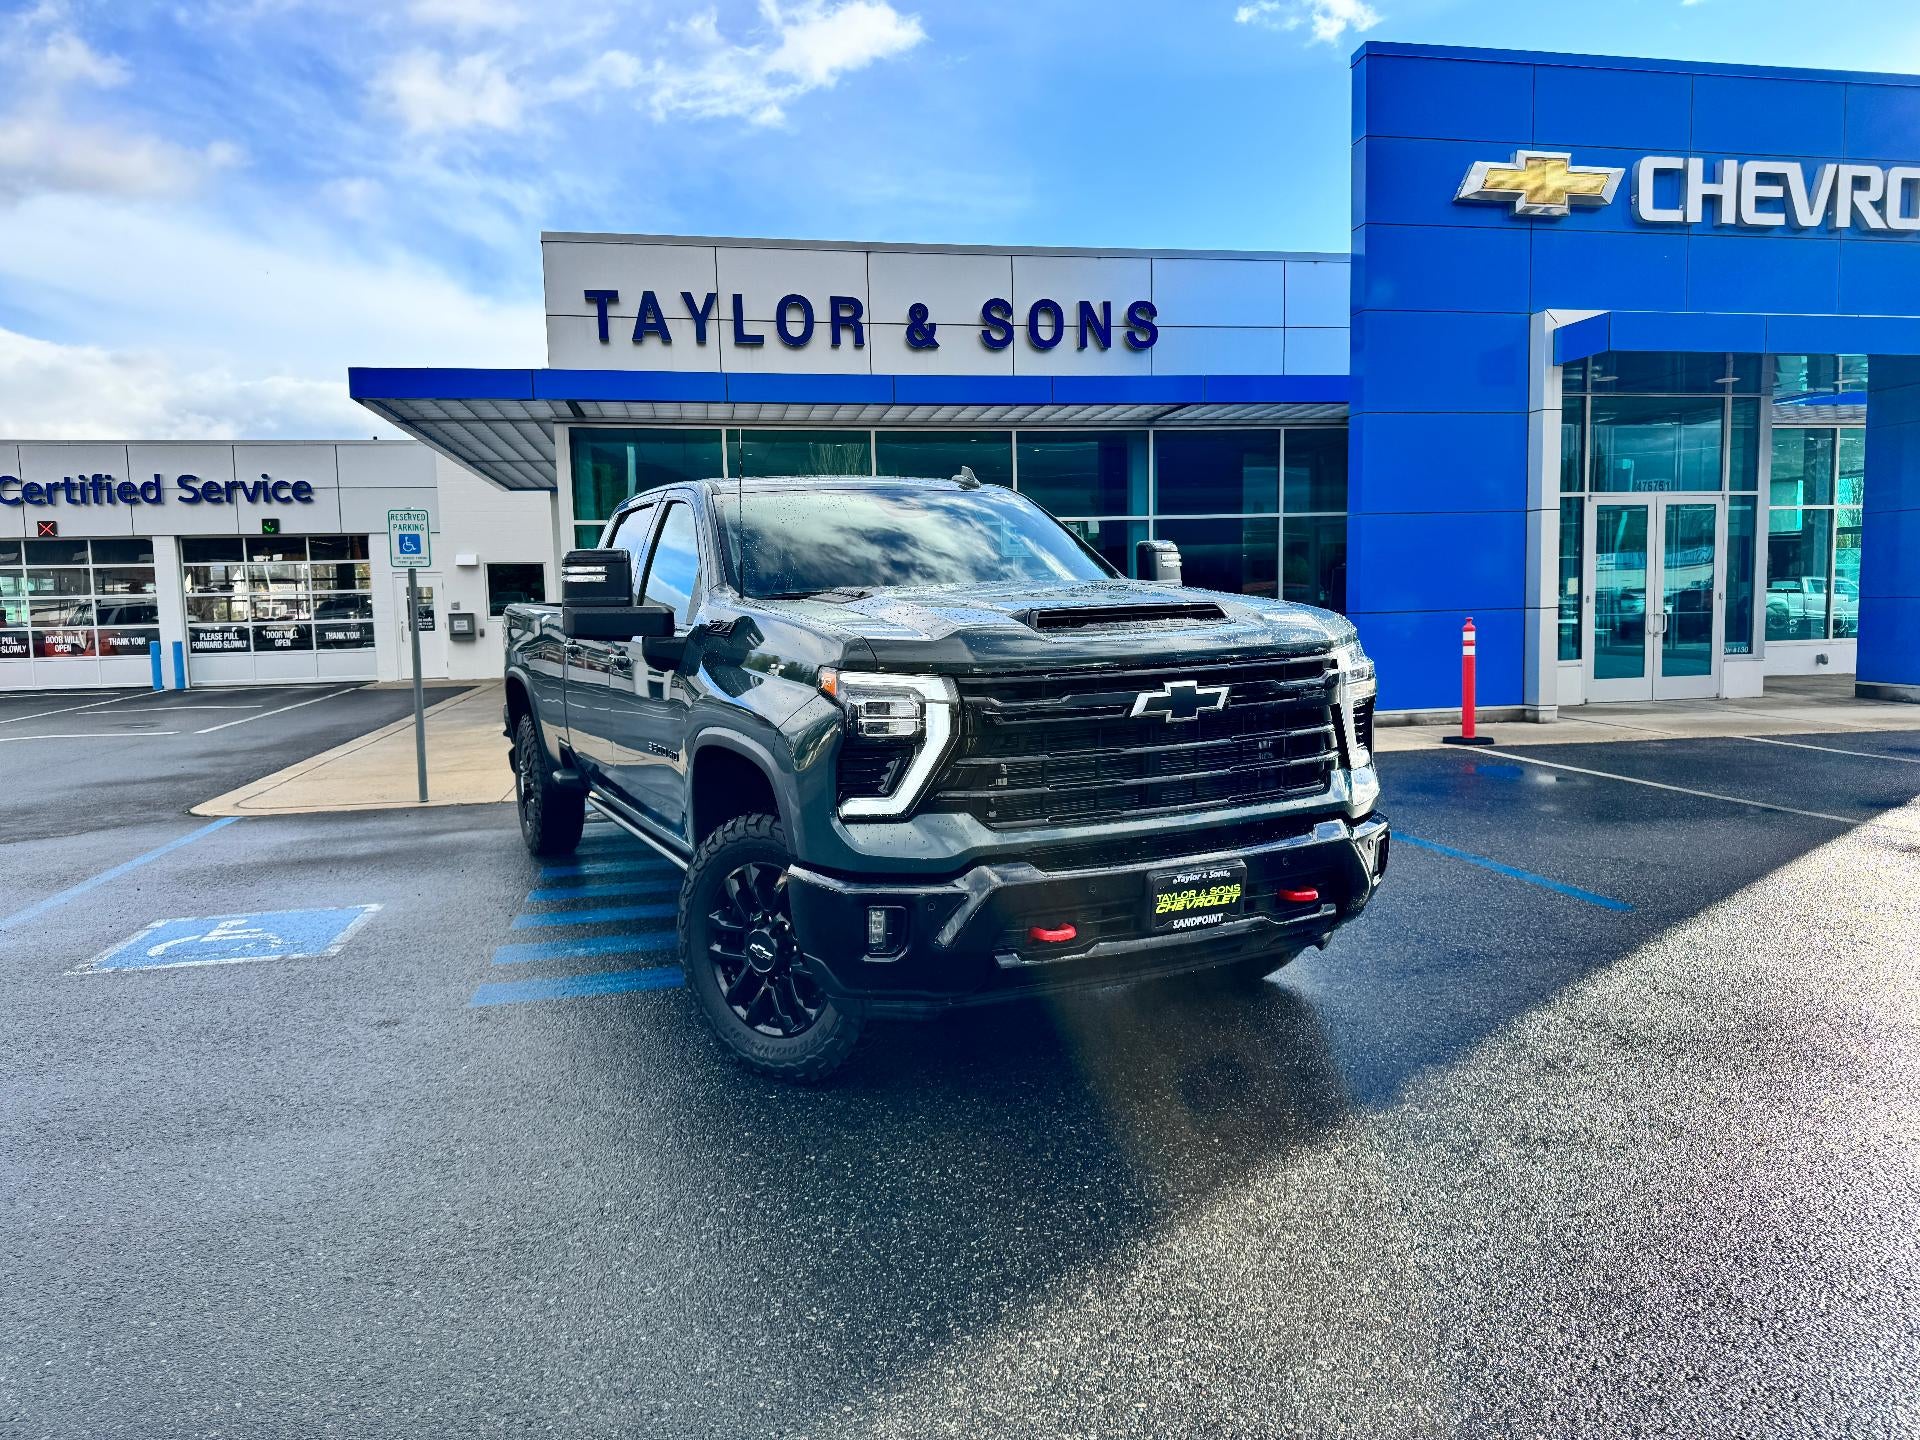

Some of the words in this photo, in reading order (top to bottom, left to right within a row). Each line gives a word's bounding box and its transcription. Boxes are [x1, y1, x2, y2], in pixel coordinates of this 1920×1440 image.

[584, 289, 865, 347] TAYLOR
[905, 302, 939, 349] &
[980, 297, 1160, 351] SONS
[0, 474, 165, 506] Certified
[177, 474, 314, 505] Service
[390, 513, 426, 521] RESERVED
[392, 523, 425, 532] PARKING
[45, 635, 63, 644] DOOR
[64, 635, 81, 644] WILL
[199, 631, 223, 641] PLEASE
[223, 631, 239, 641] PULL
[266, 630, 284, 639] DOOR
[325, 631, 343, 640] THANK
[344, 630, 361, 640] YOU!
[1, 636, 18, 645] PULL
[109, 637, 129, 646] THANK
[130, 636, 146, 645] YOU!
[191, 640, 225, 650] FORWARD
[225, 639, 247, 649] SLOWLY
[274, 638, 291, 647] OPEN
[1, 645, 27, 654] SLOWLY
[54, 643, 72, 652] OPEN
[1176, 873, 1201, 884] Taylor
[1208, 870, 1228, 879] Sons
[1156, 890, 1196, 902] TAYLOR
[1199, 888, 1207, 898] &
[1209, 884, 1240, 895] SONS
[1155, 895, 1238, 913] CHEVROLET
[1172, 912, 1224, 929] SANDPOINT
